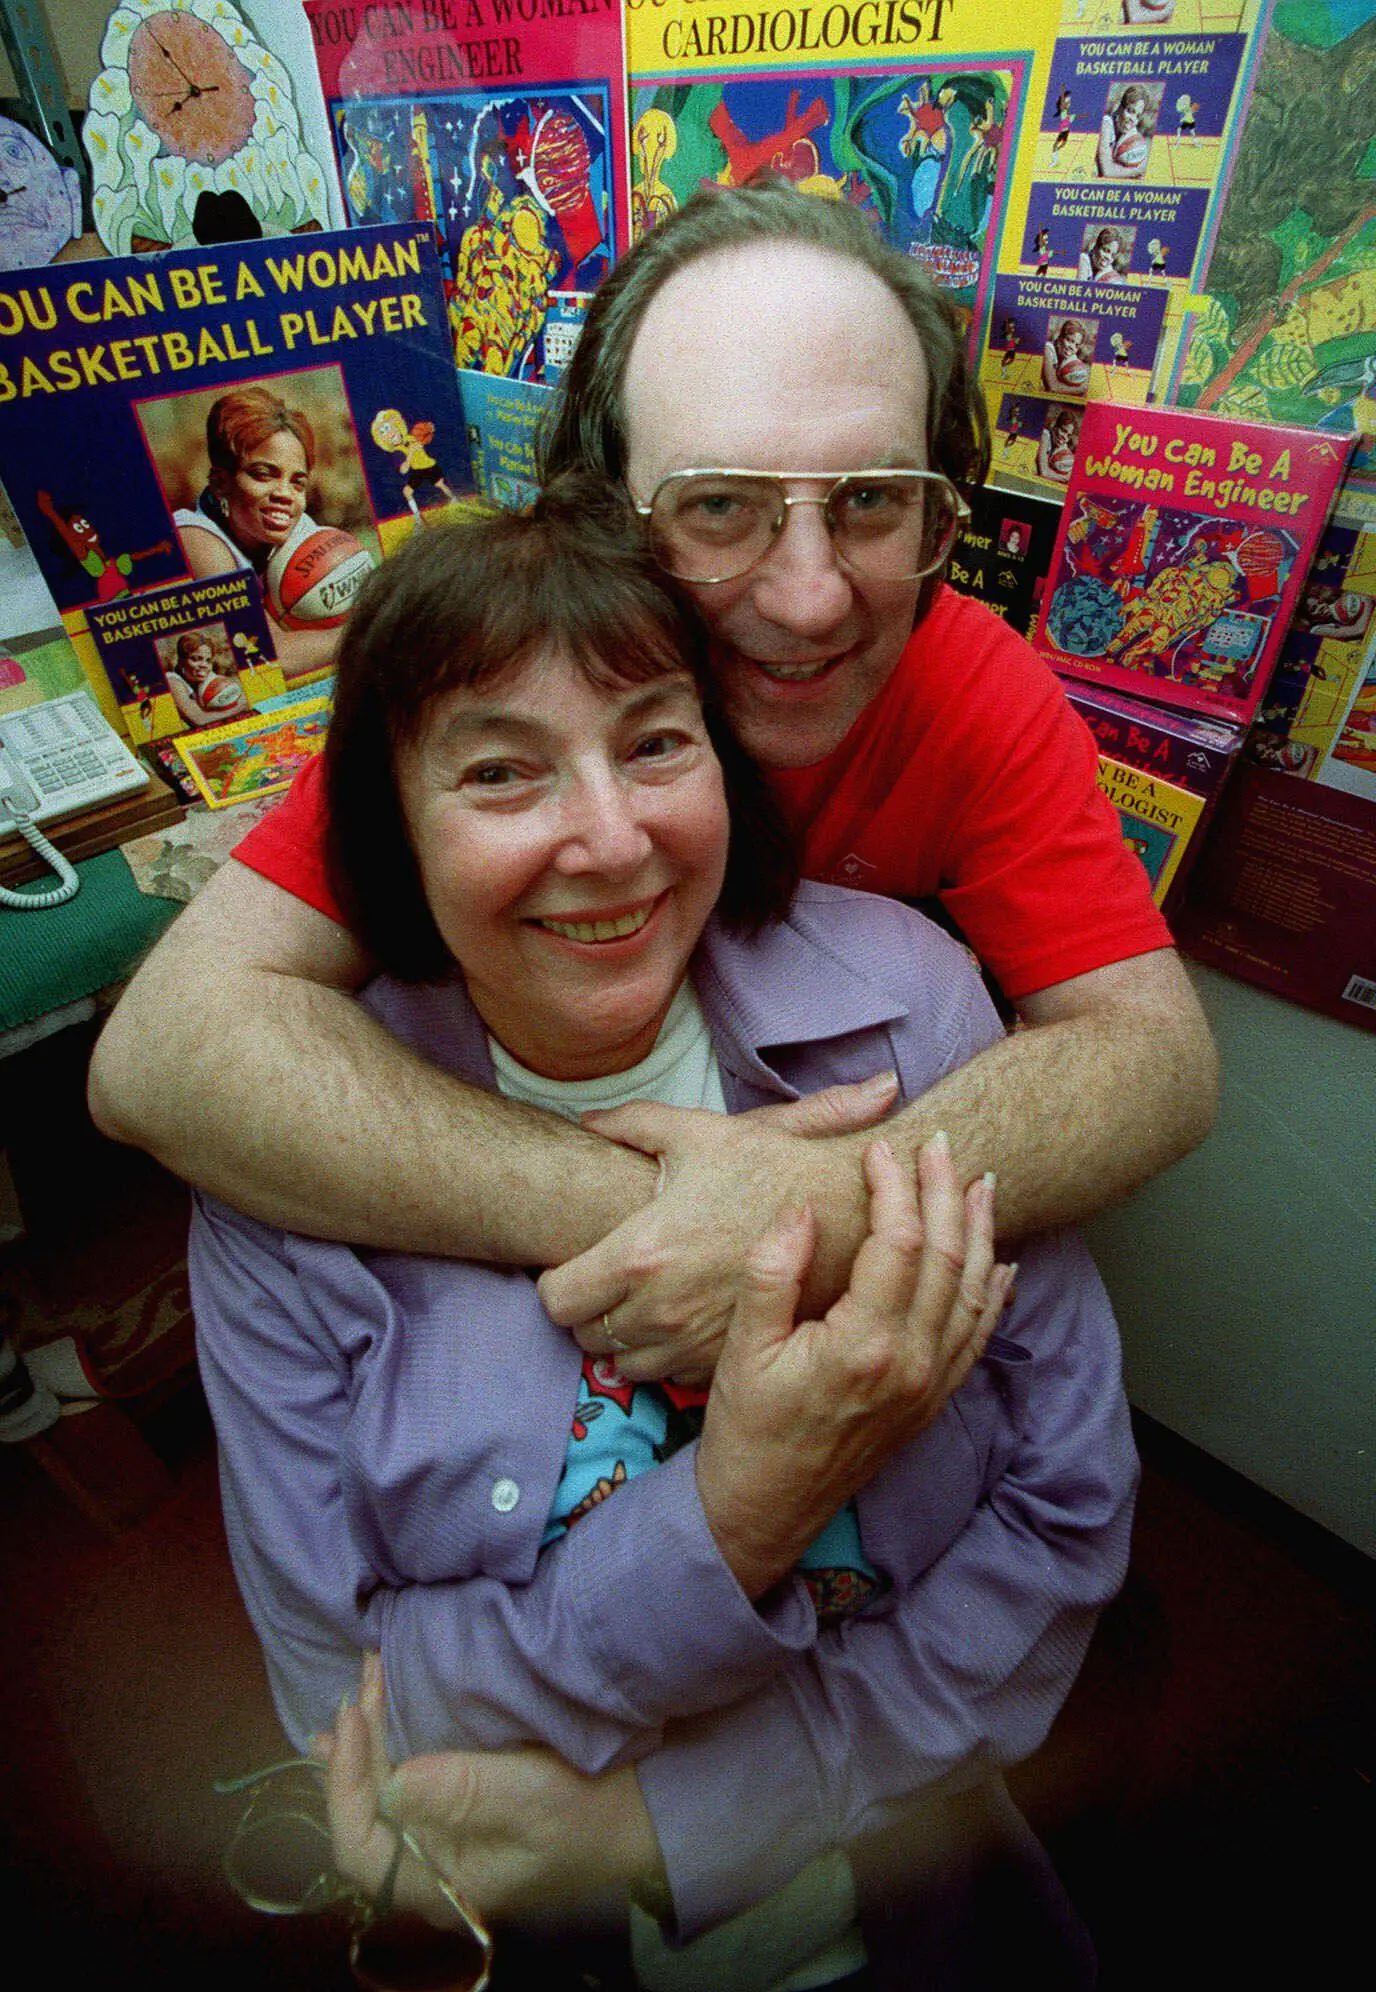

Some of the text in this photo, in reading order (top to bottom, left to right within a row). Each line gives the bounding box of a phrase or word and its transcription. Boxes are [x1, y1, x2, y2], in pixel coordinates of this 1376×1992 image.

[309, 0, 612, 46] YOU CAN BE A WOM
[662, 0, 954, 59] CARDIOLOGIST
[383, 37, 523, 85] ENGINEER
[1076, 60, 1209, 75] BASKETBALL PLAYER
[1080, 40, 1216, 56] YOU CAN BE A WOMAN
[1052, 203, 1176, 222] BASKETBALL PLAYER
[1055, 188, 1182, 205] YOU CAN BE A WOMAN
[66, 273, 165, 324] CAN
[168, 264, 227, 310] BE
[236, 261, 265, 300] A
[264, 239, 421, 295] WOMAN
[1019, 280, 1141, 303] YOU CAN BE A WOMAN
[280, 293, 428, 350] PLAYER
[1017, 294, 1137, 318] BASKETBALL PLAYER
[1112, 423, 1291, 481] You Can Be A
[1085, 455, 1309, 516] Woman Engineer
[951, 562, 984, 589] Be A
[94, 579, 248, 629] YOU CAN BE A WOMAN
[102, 595, 251, 645] BASKETBALL PLAYER
[1126, 725, 1150, 753] Be
[1153, 738, 1170, 762] A
[1112, 767, 1140, 790] BE
[1141, 782, 1156, 797] A
